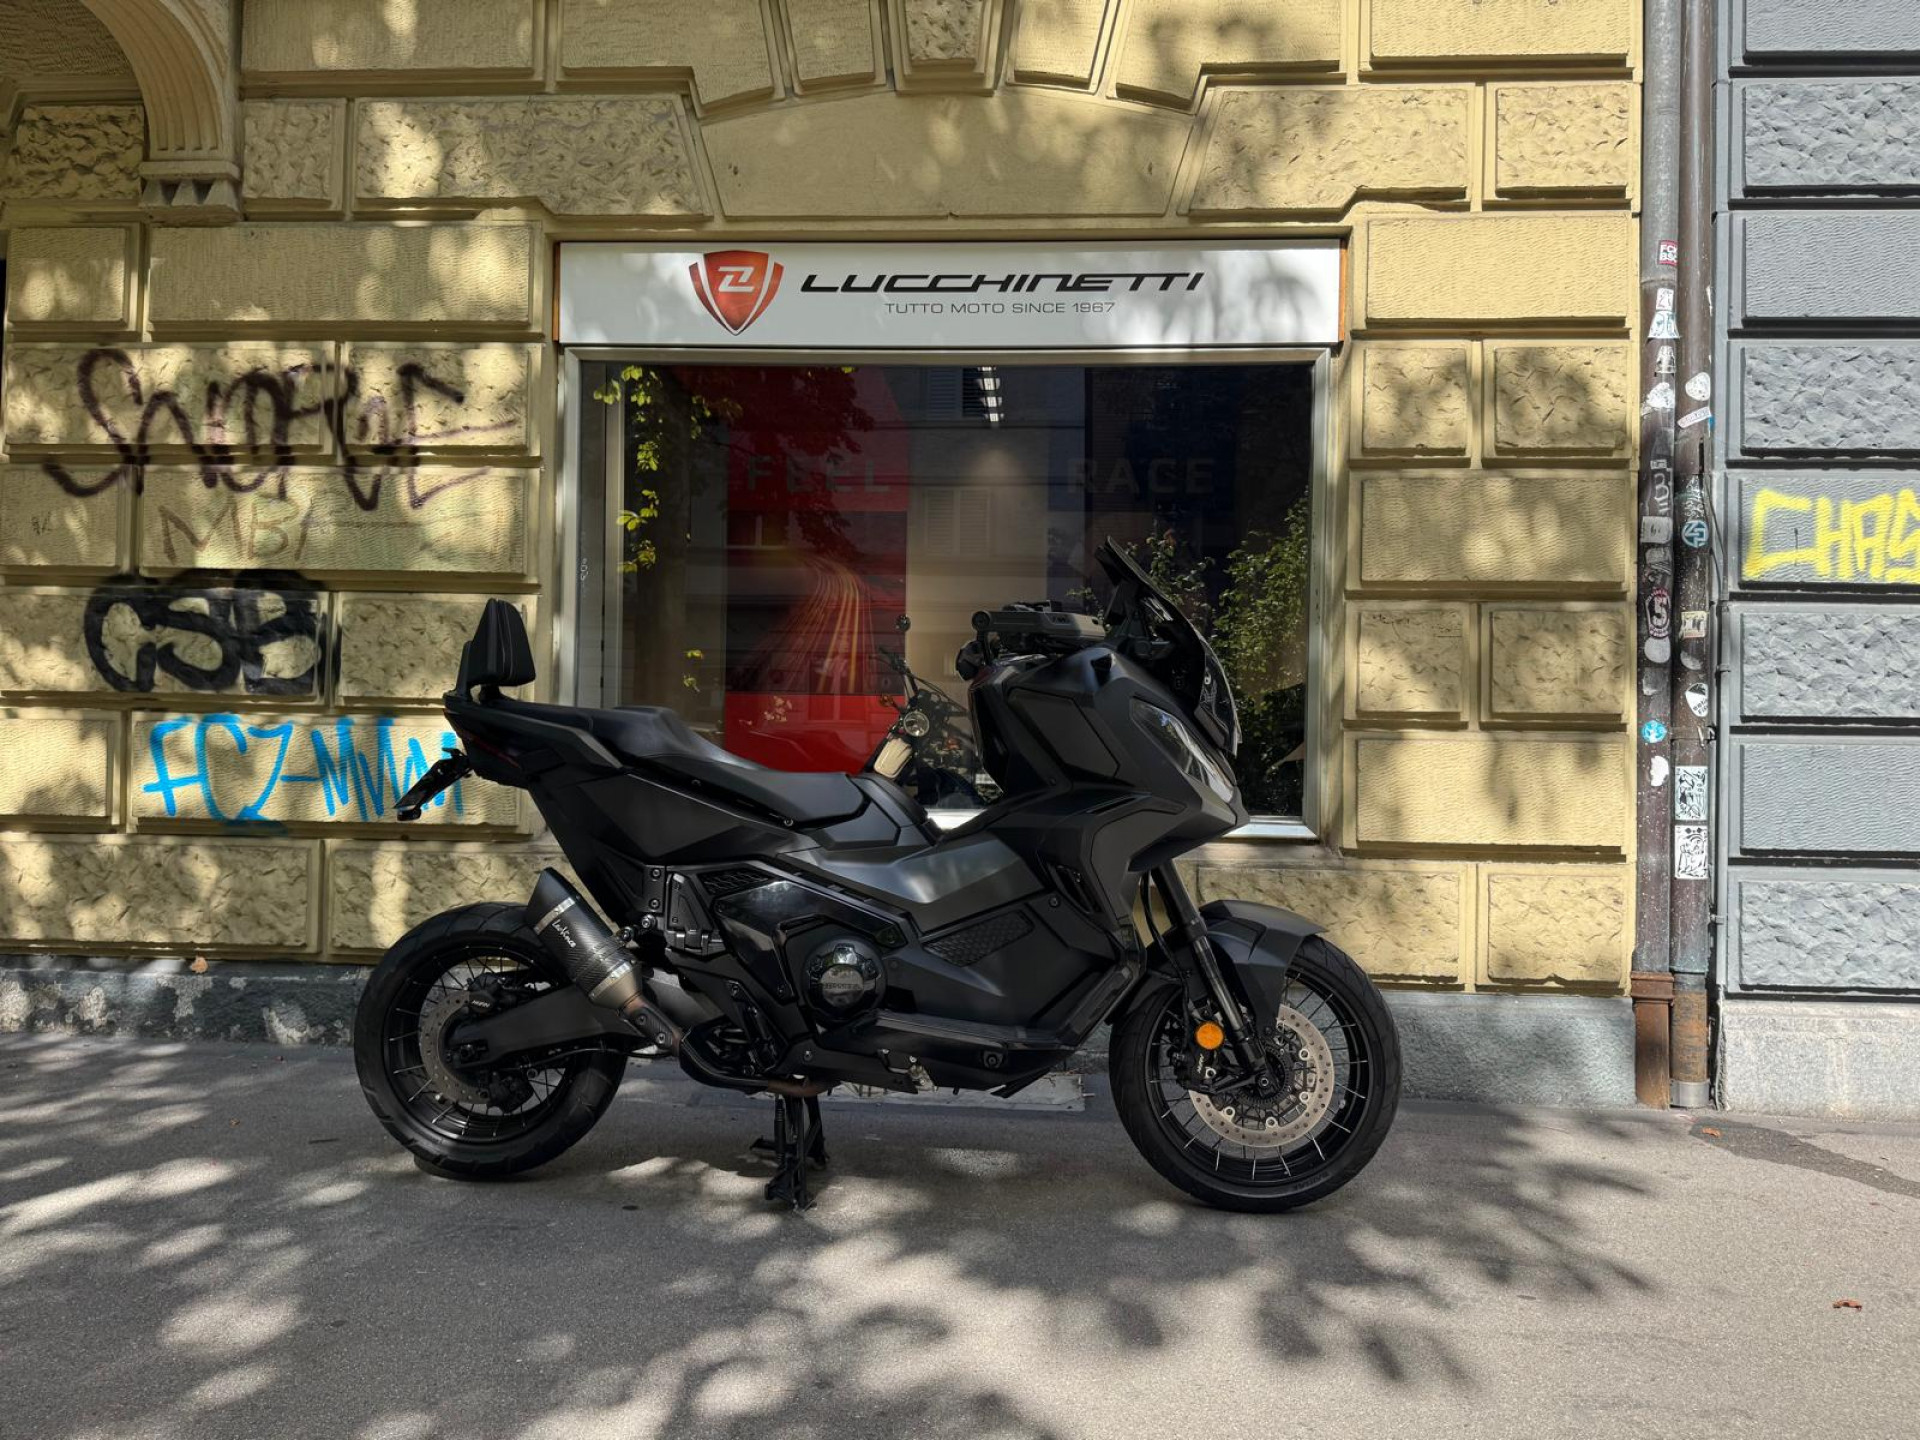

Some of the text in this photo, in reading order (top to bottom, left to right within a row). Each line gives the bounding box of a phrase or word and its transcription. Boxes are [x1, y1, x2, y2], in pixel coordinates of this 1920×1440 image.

[800, 272, 1205, 292] LUCCHINETTI
[885, 302, 1116, 314] TUTTO MOTO SINCE 1967
[1066, 457, 1214, 493] RACE
